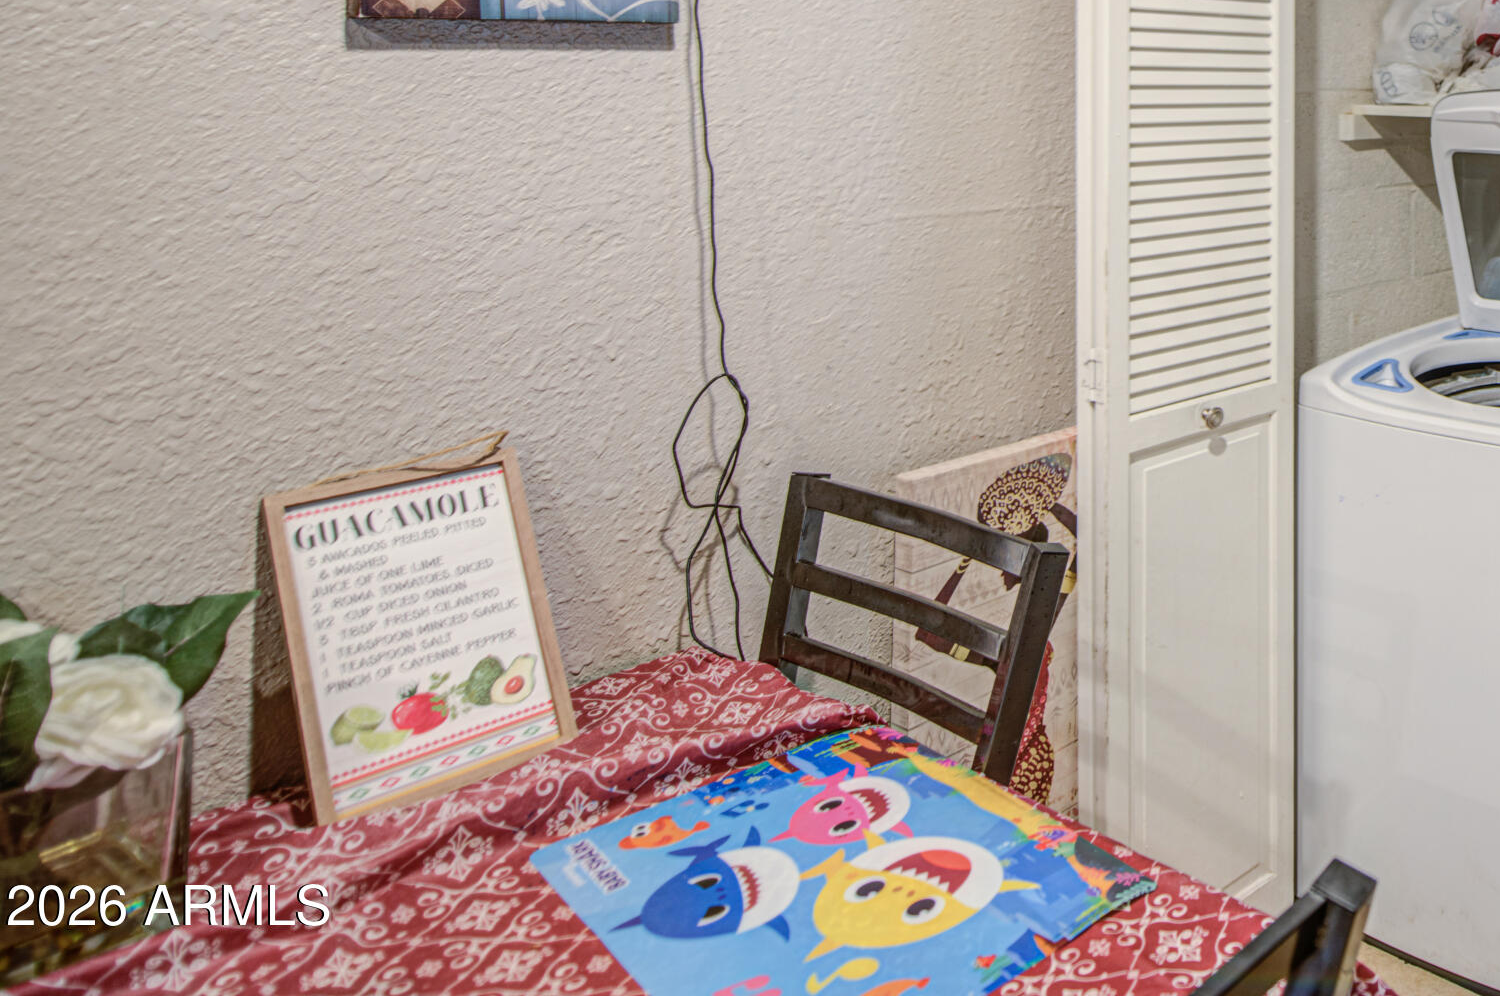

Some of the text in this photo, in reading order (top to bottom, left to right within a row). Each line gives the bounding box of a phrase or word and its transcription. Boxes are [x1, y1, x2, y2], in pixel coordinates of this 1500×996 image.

[295, 482, 500, 551] GUACAMOLE
[393, 527, 439, 545] PEELED
[312, 555, 444, 599] JUICE OF ONE LIME
[331, 589, 375, 609] ROMA
[381, 569, 450, 596] TOMATOES
[456, 557, 494, 576] DICED
[334, 555, 388, 577] MASHED
[344, 604, 374, 621] CUP
[377, 593, 420, 613] DICED
[424, 580, 468, 601] ONION
[384, 606, 430, 628] FRESH
[434, 586, 500, 613] CILANTRO
[336, 627, 414, 658] TEASPOON
[417, 612, 469, 636] MINCED
[471, 596, 518, 619] GARLIC
[325, 627, 517, 696] PINCH OF CAYENNE PEPPER
[340, 643, 417, 674] TEASPOON
[420, 631, 452, 651] SALT
